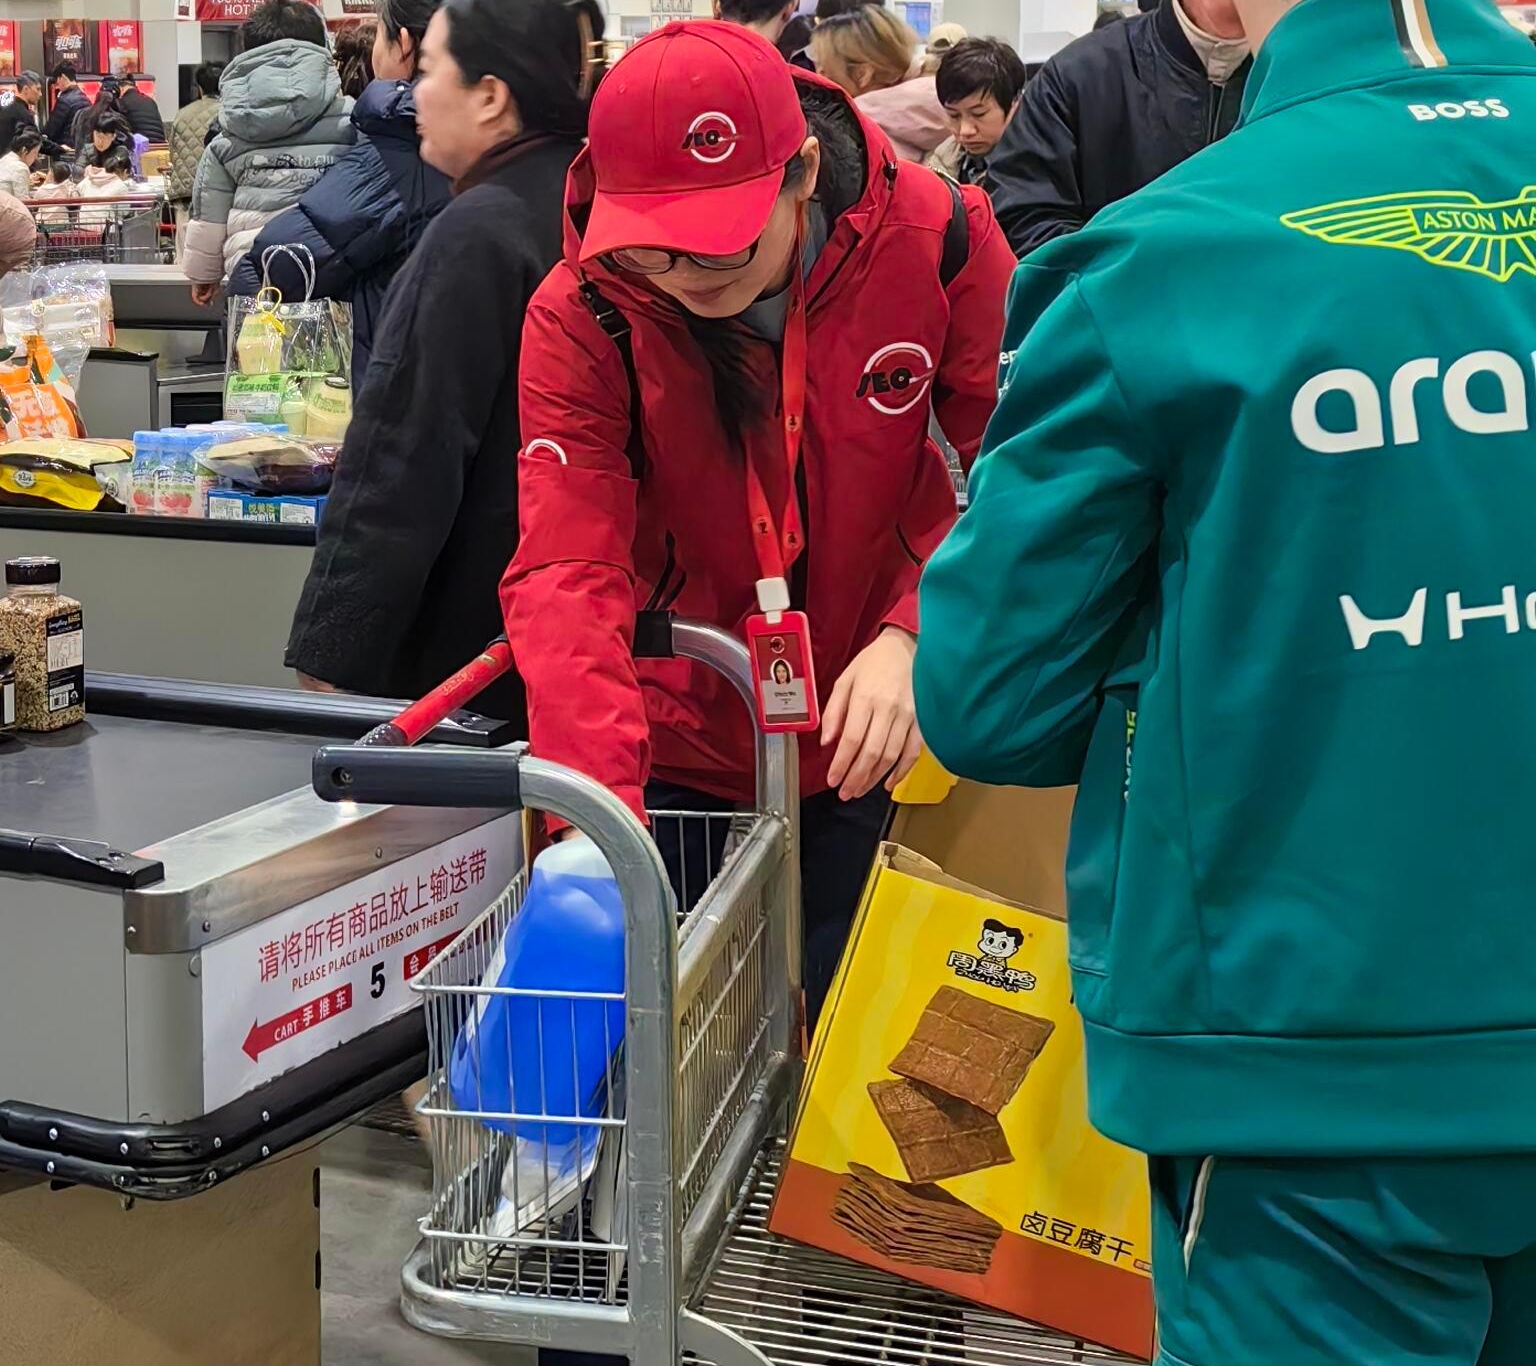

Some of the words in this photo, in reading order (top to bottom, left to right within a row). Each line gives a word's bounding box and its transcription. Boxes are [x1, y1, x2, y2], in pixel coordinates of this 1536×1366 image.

[1408, 99, 1510, 122] BOSS
[1424, 210, 1496, 231] ASTON
[1292, 349, 1536, 453] ara
[259, 848, 487, 983] 请将所有商品放上输送带
[292, 965, 327, 992] PLEASE
[376, 931, 404, 953] ITEMS
[440, 902, 459, 925] BELT
[947, 950, 1037, 990] 周黑鸭
[370, 962, 385, 999] 5
[274, 1019, 298, 1042] CART
[302, 988, 347, 1027] 手推车
[1019, 1212, 1135, 1262] 卤豆腐干
